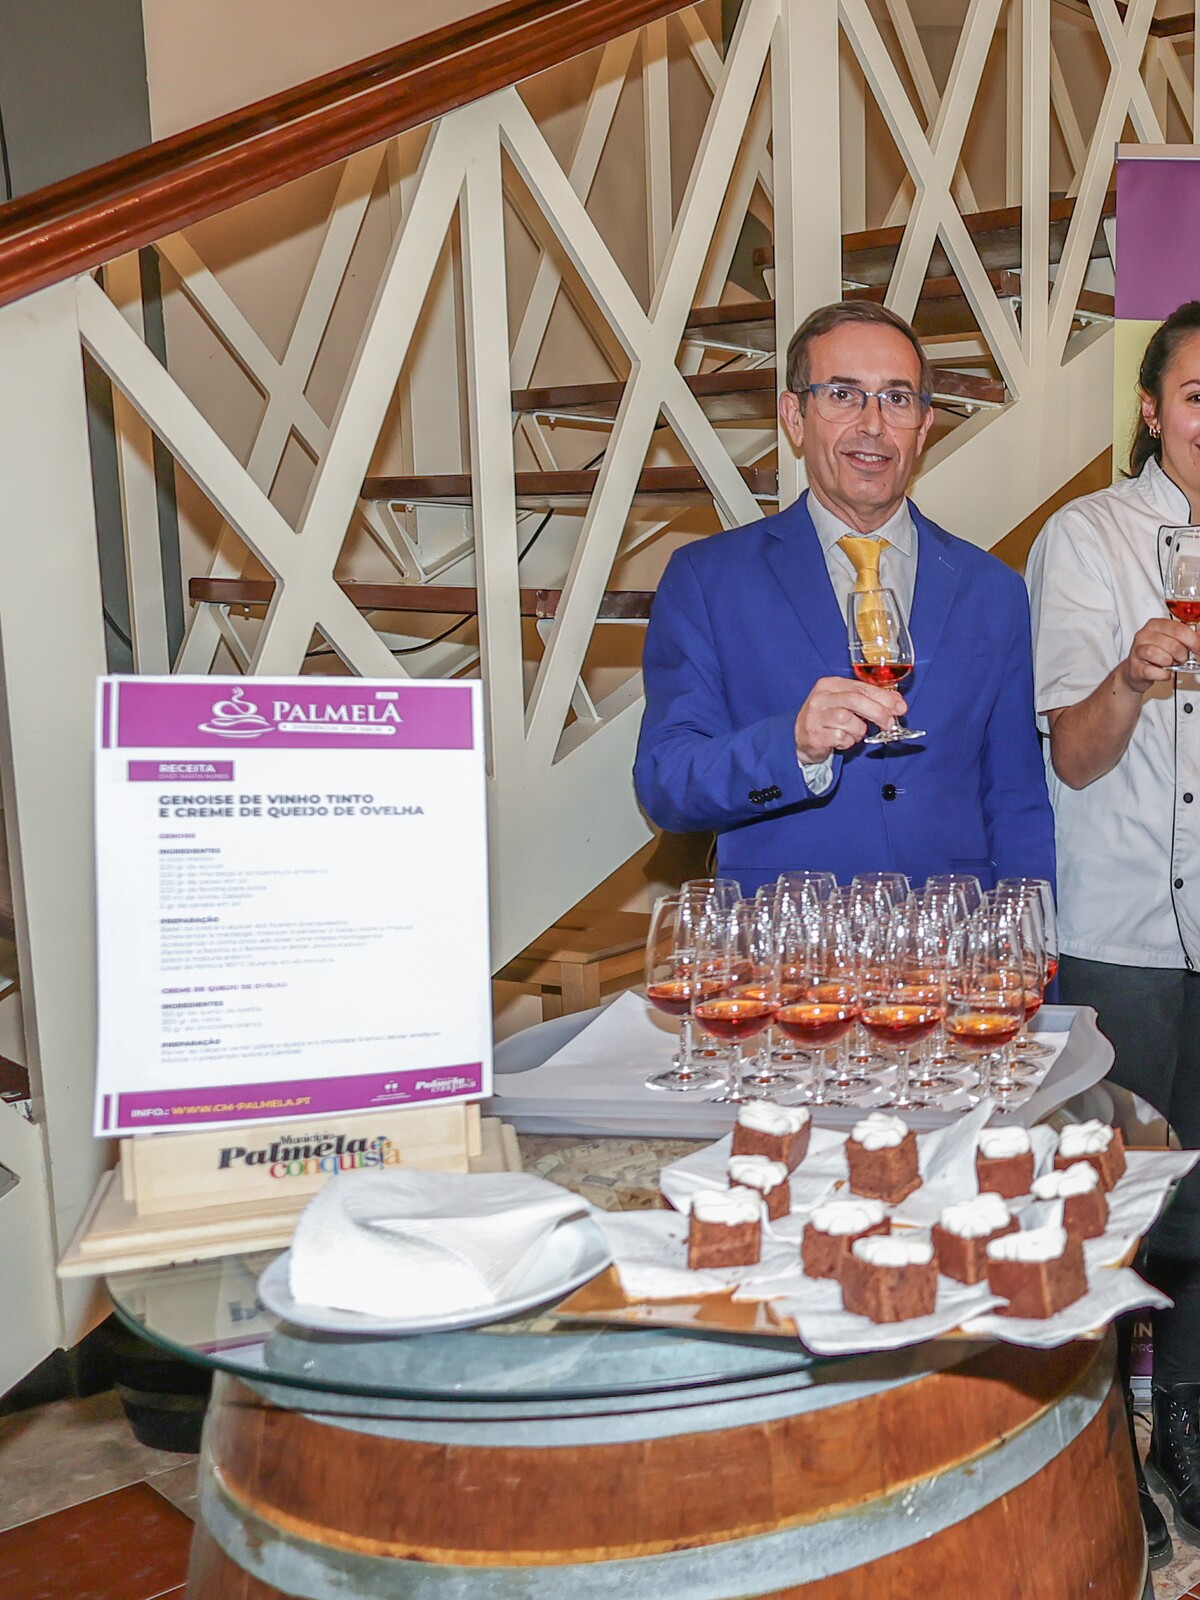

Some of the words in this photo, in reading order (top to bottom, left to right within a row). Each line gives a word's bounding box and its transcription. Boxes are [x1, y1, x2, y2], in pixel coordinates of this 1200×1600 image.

[273, 701, 403, 723] PALMELA
[159, 764, 216, 773] RECEITA
[159, 795, 235, 805] GENOISE
[240, 795, 262, 804] DE
[267, 795, 321, 805] VINHO
[326, 794, 374, 804] TINTO
[160, 808, 169, 817] E
[175, 808, 235, 817] CREME
[240, 807, 262, 817] DE
[267, 807, 328, 818] QUEIJO
[334, 807, 355, 816] DE
[360, 806, 425, 815] OVELHA
[217, 1134, 368, 1170] Palmela
[268, 1145, 402, 1180] conquista
